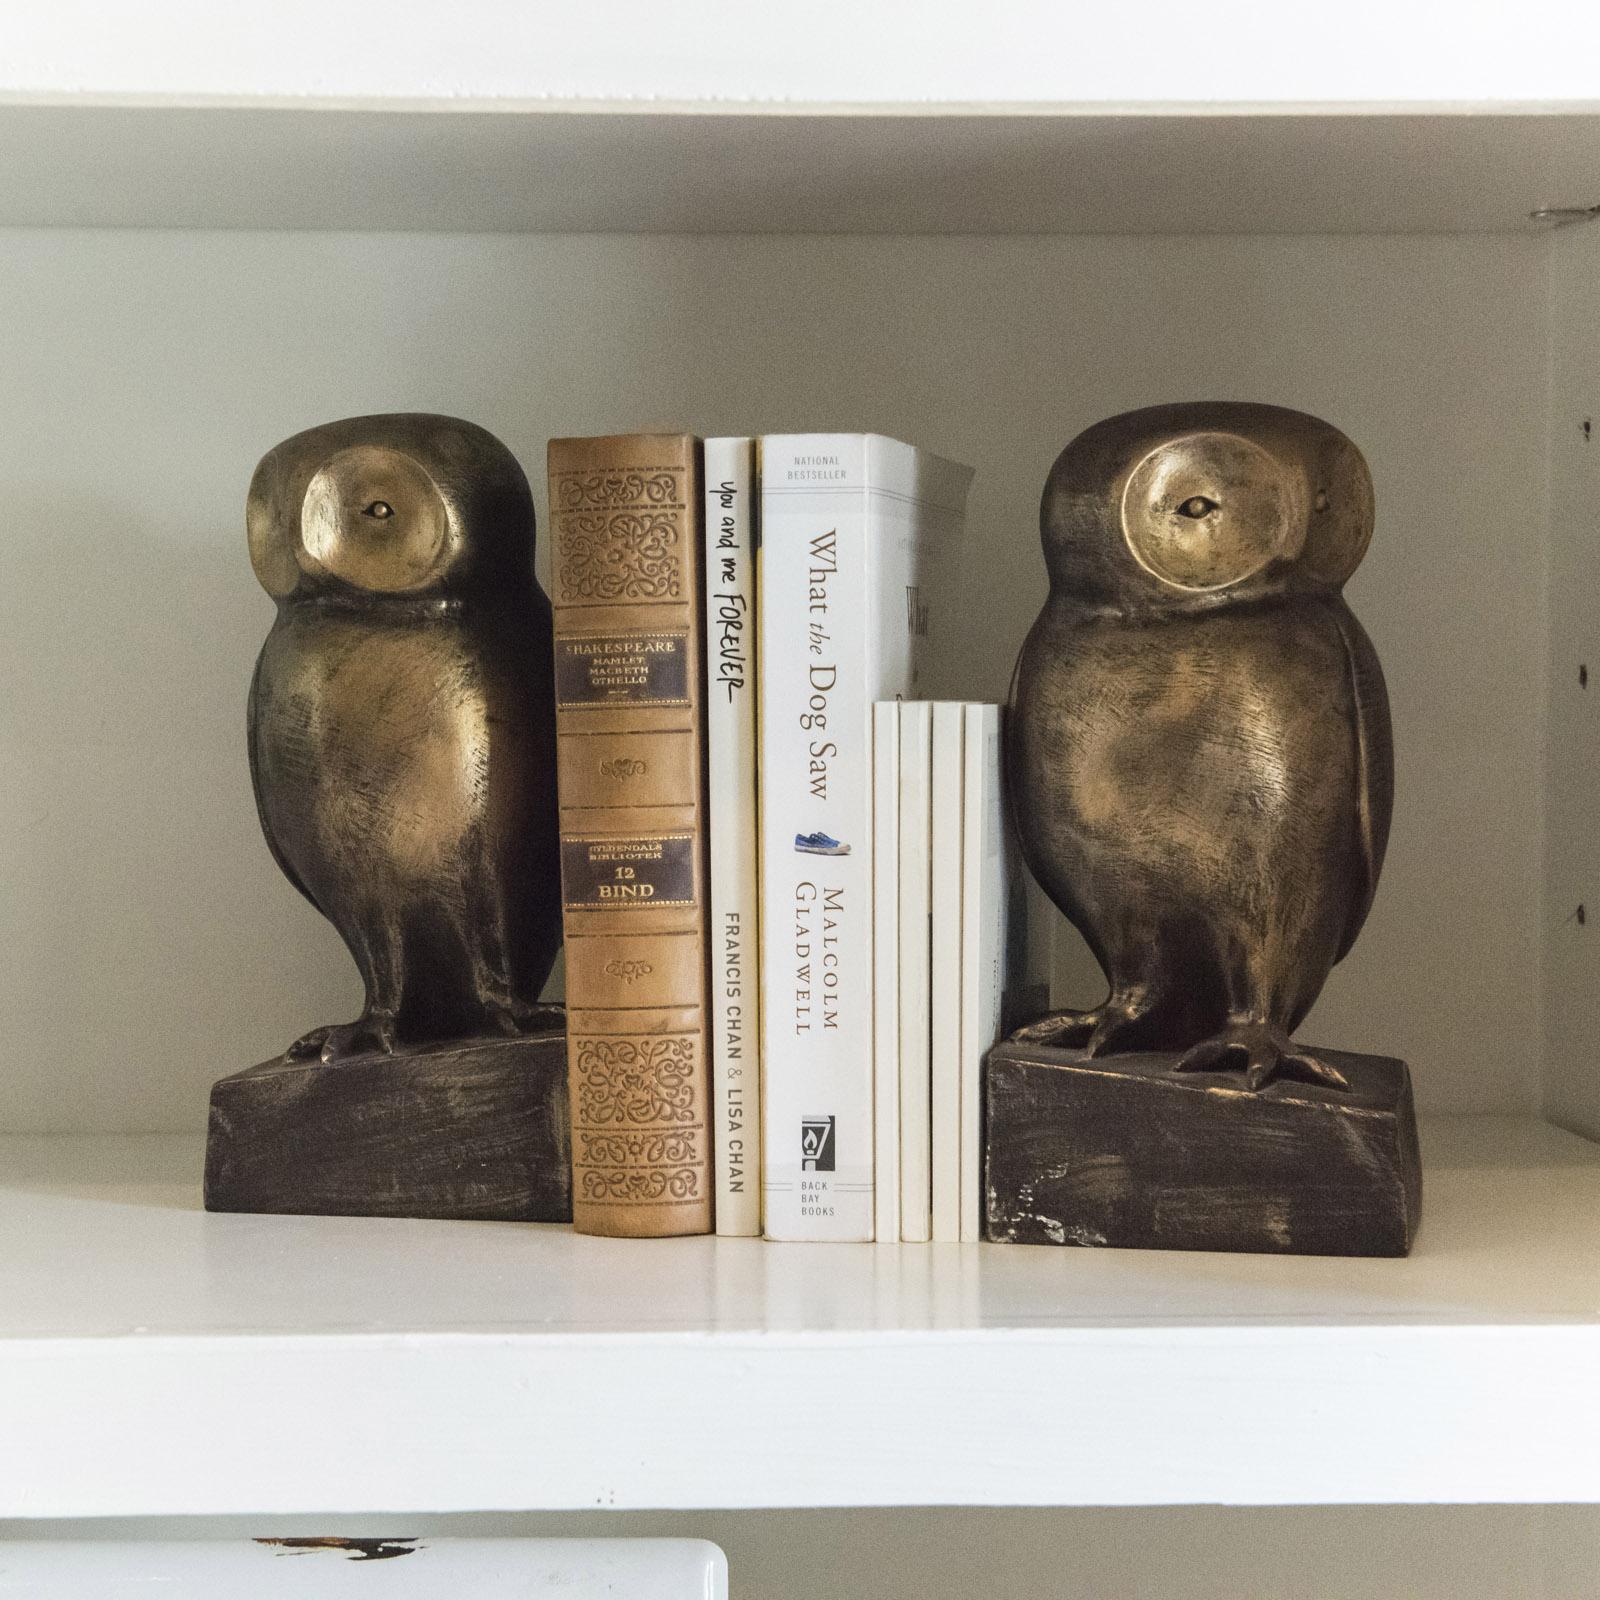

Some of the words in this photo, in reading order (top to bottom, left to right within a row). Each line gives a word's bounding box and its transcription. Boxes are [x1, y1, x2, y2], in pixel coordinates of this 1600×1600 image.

[794, 456, 839, 465] NATIONAL
[787, 470, 846, 480] BESTSELLER
[709, 481, 737, 509] you
[716, 517, 740, 549] and
[721, 558, 737, 584] me
[808, 527, 837, 613] What
[566, 641, 676, 655] SHAKESPEARE
[713, 594, 747, 704] FOREVER
[809, 622, 831, 655] the
[589, 666, 649, 676] MACBETH
[593, 657, 645, 666] HAMLET
[592, 676, 647, 685] OTHELLO
[800, 664, 837, 730] Dog
[809, 741, 837, 800] Saw
[589, 852, 662, 861] BIBLIOTEK
[615, 866, 635, 879] 12
[599, 884, 654, 898] BIND
[725, 912, 741, 998] FRANCIS
[795, 881, 817, 1035] GLADWELL
[823, 887, 844, 1029] MALCOLM
[726, 1006, 742, 1059] CHAN
[727, 1067, 742, 1080] &
[728, 1089, 743, 1132] LISA
[728, 1140, 744, 1193] CHAN
[801, 1182, 828, 1190] BACK
[801, 1194, 820, 1203] BAY
[801, 1207, 835, 1216] BOOKS
